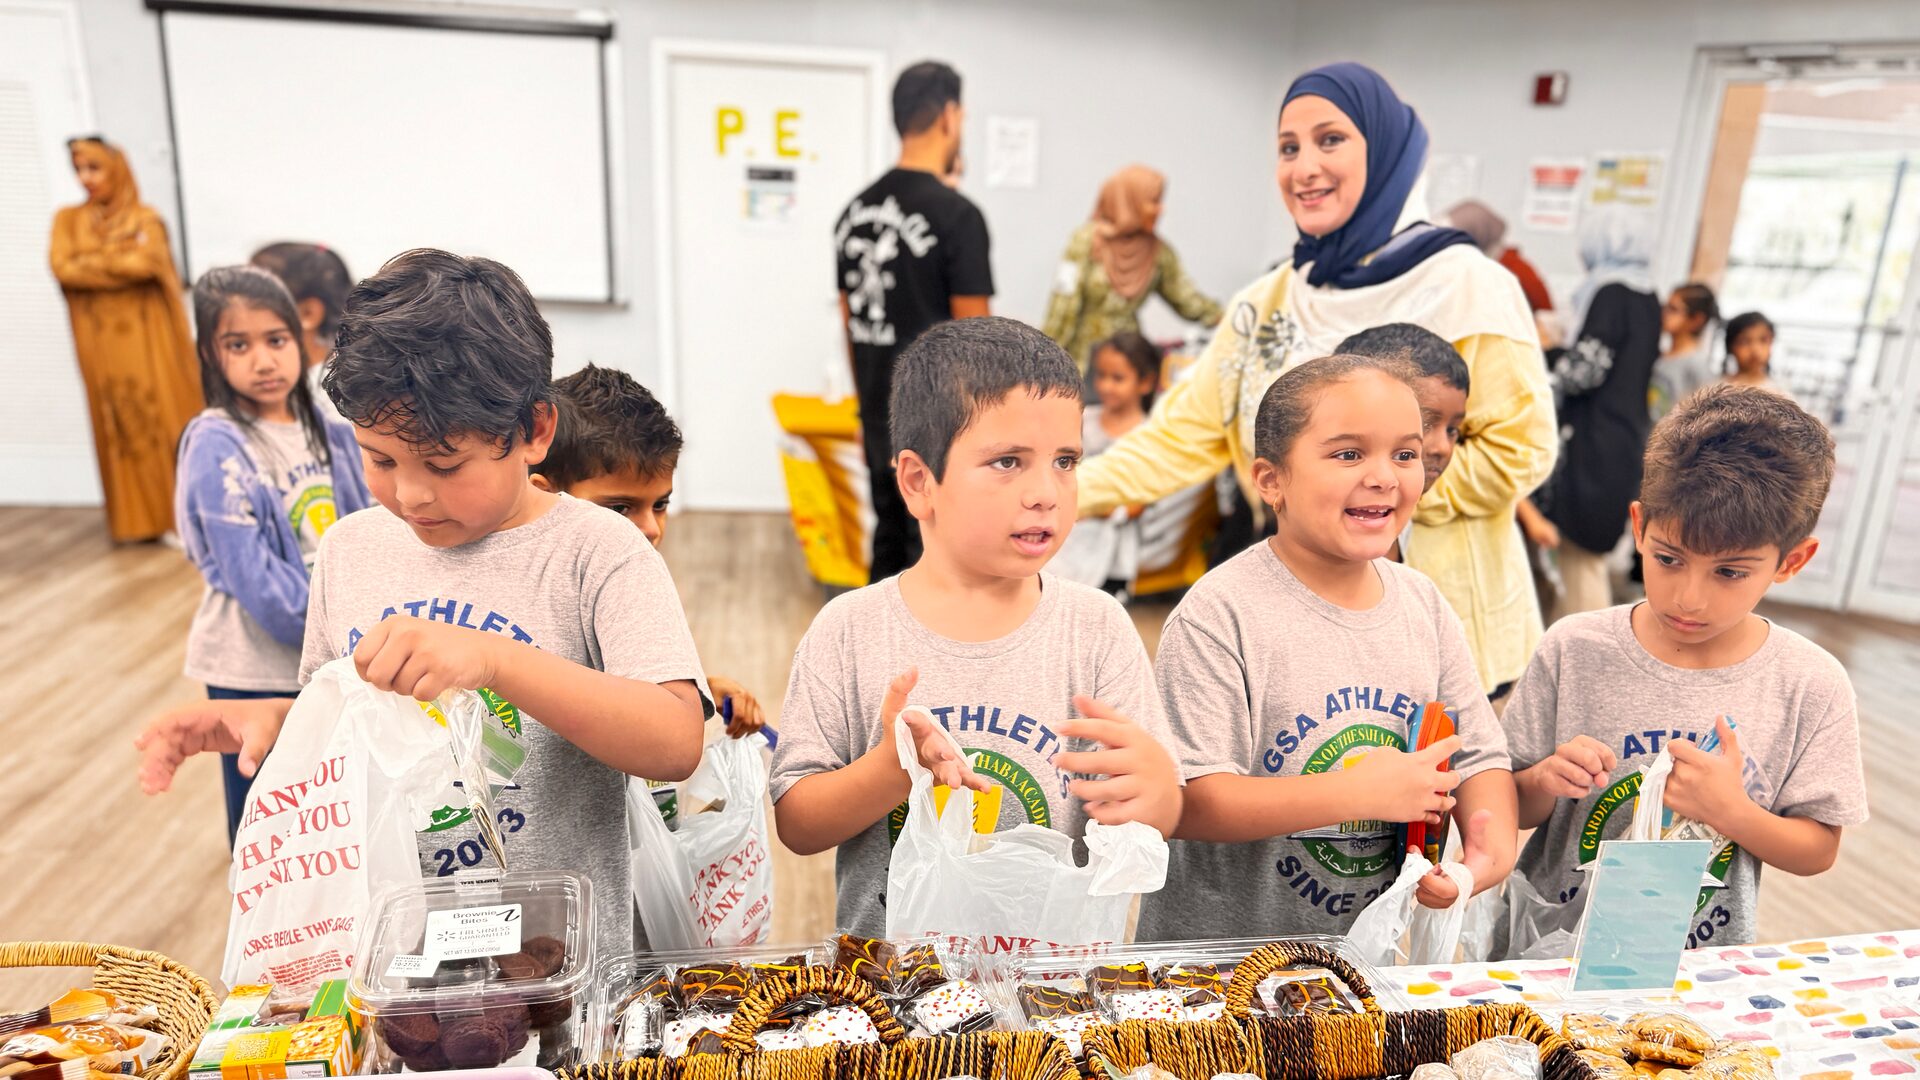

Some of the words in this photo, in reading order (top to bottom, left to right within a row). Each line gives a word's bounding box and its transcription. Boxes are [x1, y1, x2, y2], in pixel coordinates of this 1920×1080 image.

[381, 597, 542, 648] THLET
[1263, 713, 1320, 773] GSA
[1325, 686, 1421, 725] ATHLET
[976, 753, 1018, 784] HABA
[298, 801, 351, 836] YOU
[1582, 793, 1617, 850] GARDEN
[296, 845, 361, 880] YOU
[1276, 855, 1356, 917] SINCE
[453, 910, 497, 919] Brownie
[746, 901, 765, 919] THIS
[303, 918, 334, 940] THIS
[1684, 905, 1731, 951] 003
